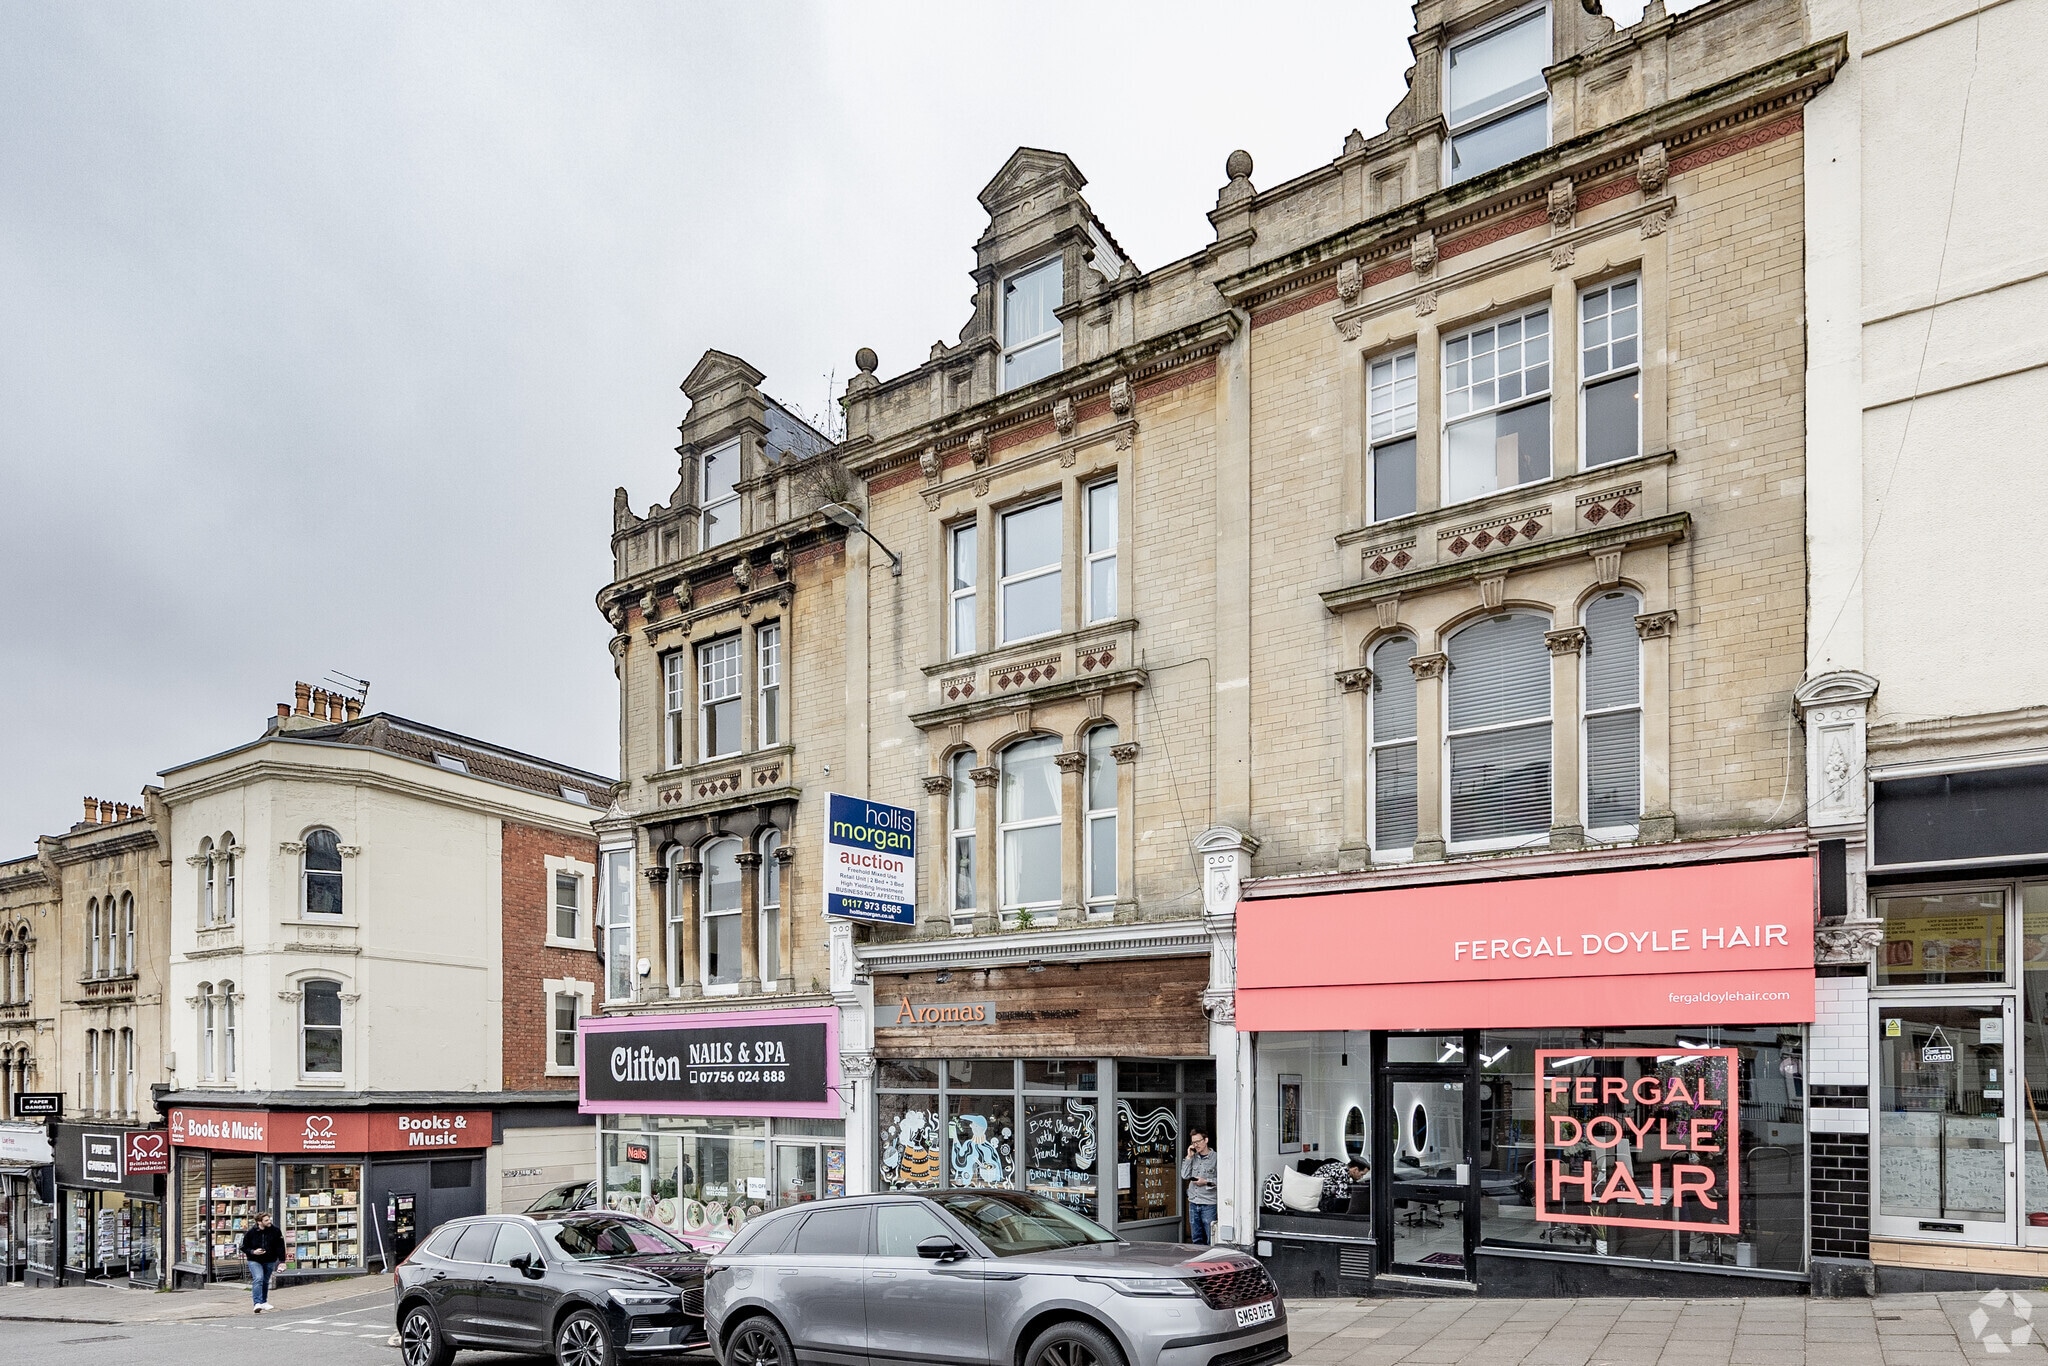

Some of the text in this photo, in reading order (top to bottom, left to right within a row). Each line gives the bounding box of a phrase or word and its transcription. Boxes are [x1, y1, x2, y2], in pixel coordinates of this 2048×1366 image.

[866, 803, 912, 832] hollis
[833, 821, 911, 850] morgan
[840, 851, 904, 873] auction
[848, 866, 870, 875] Freehold
[836, 886, 863, 895] BUSINESS
[877, 893, 905, 901] AFFECTED
[854, 883, 875, 891] Yielding
[876, 885, 903, 894] Investment
[842, 898, 902, 914] 0117 973 6565
[849, 908, 895, 919] hollismorgan.co.uk
[1454, 924, 1789, 961] FERGAL DOYLE HAIR
[1668, 989, 1790, 1005] fergaldoylehair.com
[896, 996, 985, 1024] Aromas
[689, 1041, 786, 1064] NAILS & SPA
[611, 1045, 681, 1082] Clifton
[700, 1070, 786, 1083] 07756 024 888
[1550, 1076, 1722, 1106] FERGAL
[188, 1119, 263, 1141] Books & Music
[399, 1115, 467, 1130] Books &
[1030, 1118, 1053, 1134] Best
[409, 1131, 458, 1146] Music
[1550, 1115, 1720, 1152] DOYLE
[91, 1143, 112, 1155] PAPER
[627, 1145, 647, 1160] Nails
[1154, 1143, 1170, 1153] MENU
[87, 1160, 117, 1173] GANGSTA
[1029, 1168, 1052, 1181] BRING
[1056, 1170, 1061, 1178] A
[1552, 1159, 1718, 1210] HAIR
[1056, 1192, 1066, 1201] ON
[1193, 1265, 1230, 1274] RANGE
[1237, 1307, 1259, 1324] SM69
[1259, 1304, 1273, 1319] DFE
